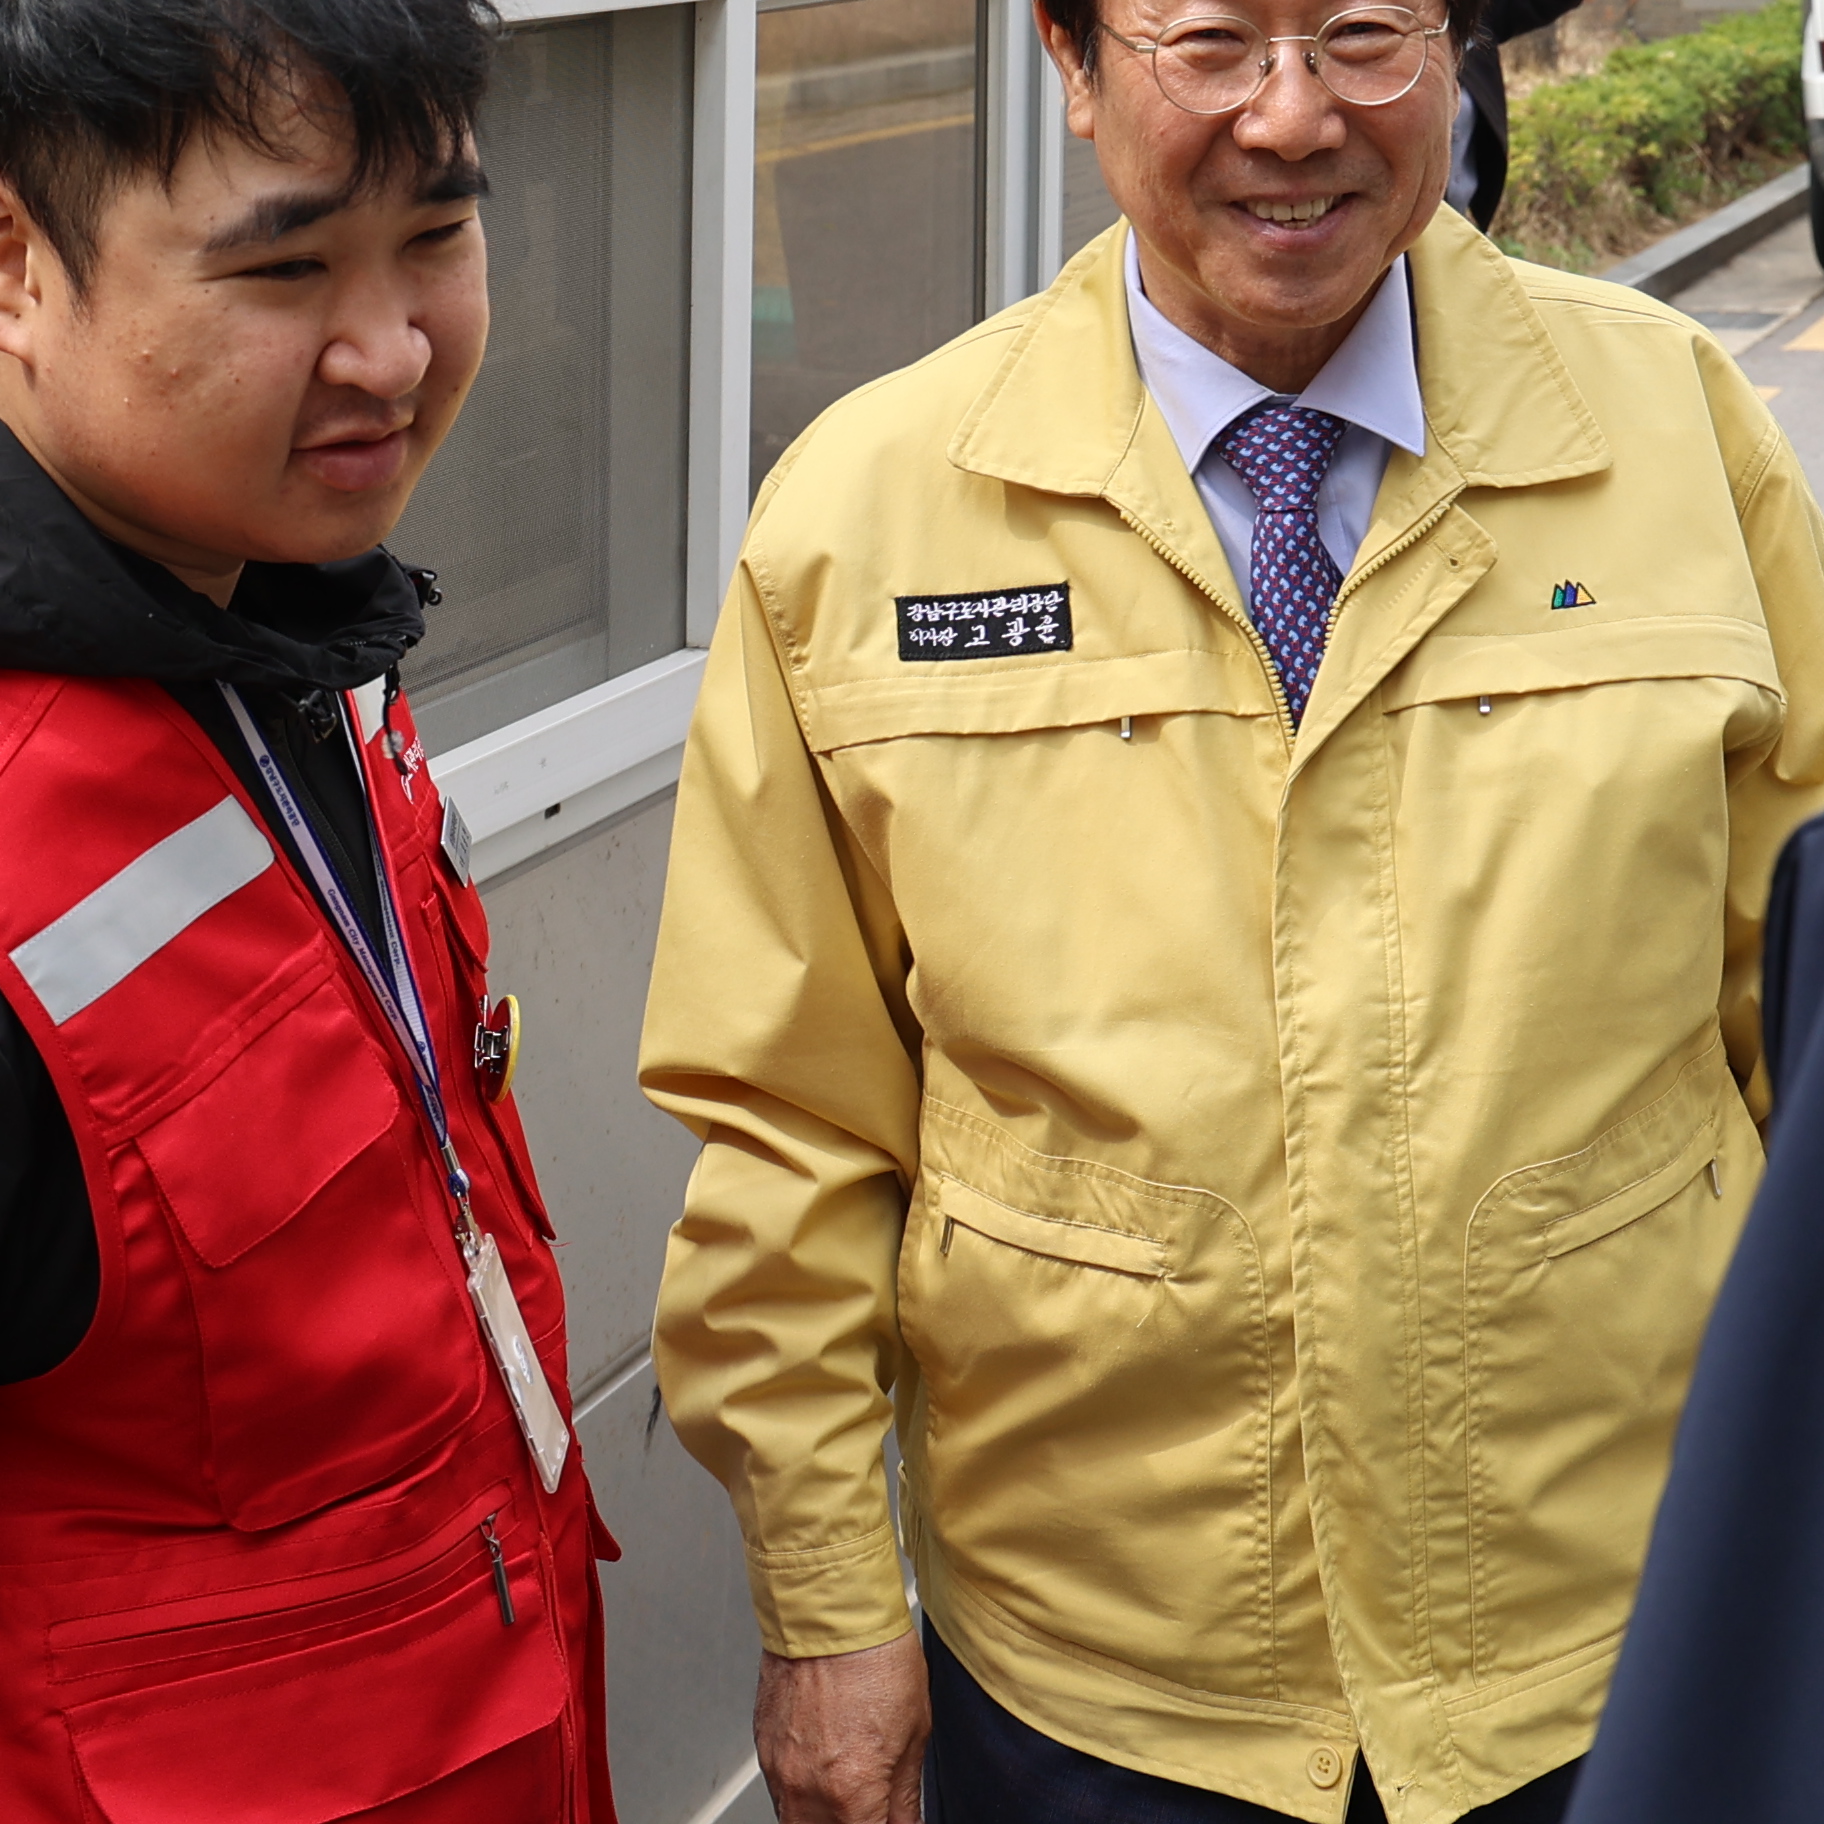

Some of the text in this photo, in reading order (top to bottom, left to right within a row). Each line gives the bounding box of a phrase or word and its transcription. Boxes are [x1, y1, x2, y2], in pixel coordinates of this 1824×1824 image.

[907, 590, 1064, 622] 강남구도시관리공단
[910, 627, 958, 647] 이사장
[327, 889, 350, 928] Gangnam
[348, 928, 361, 946] City
[383, 996, 399, 1023] Corp.
